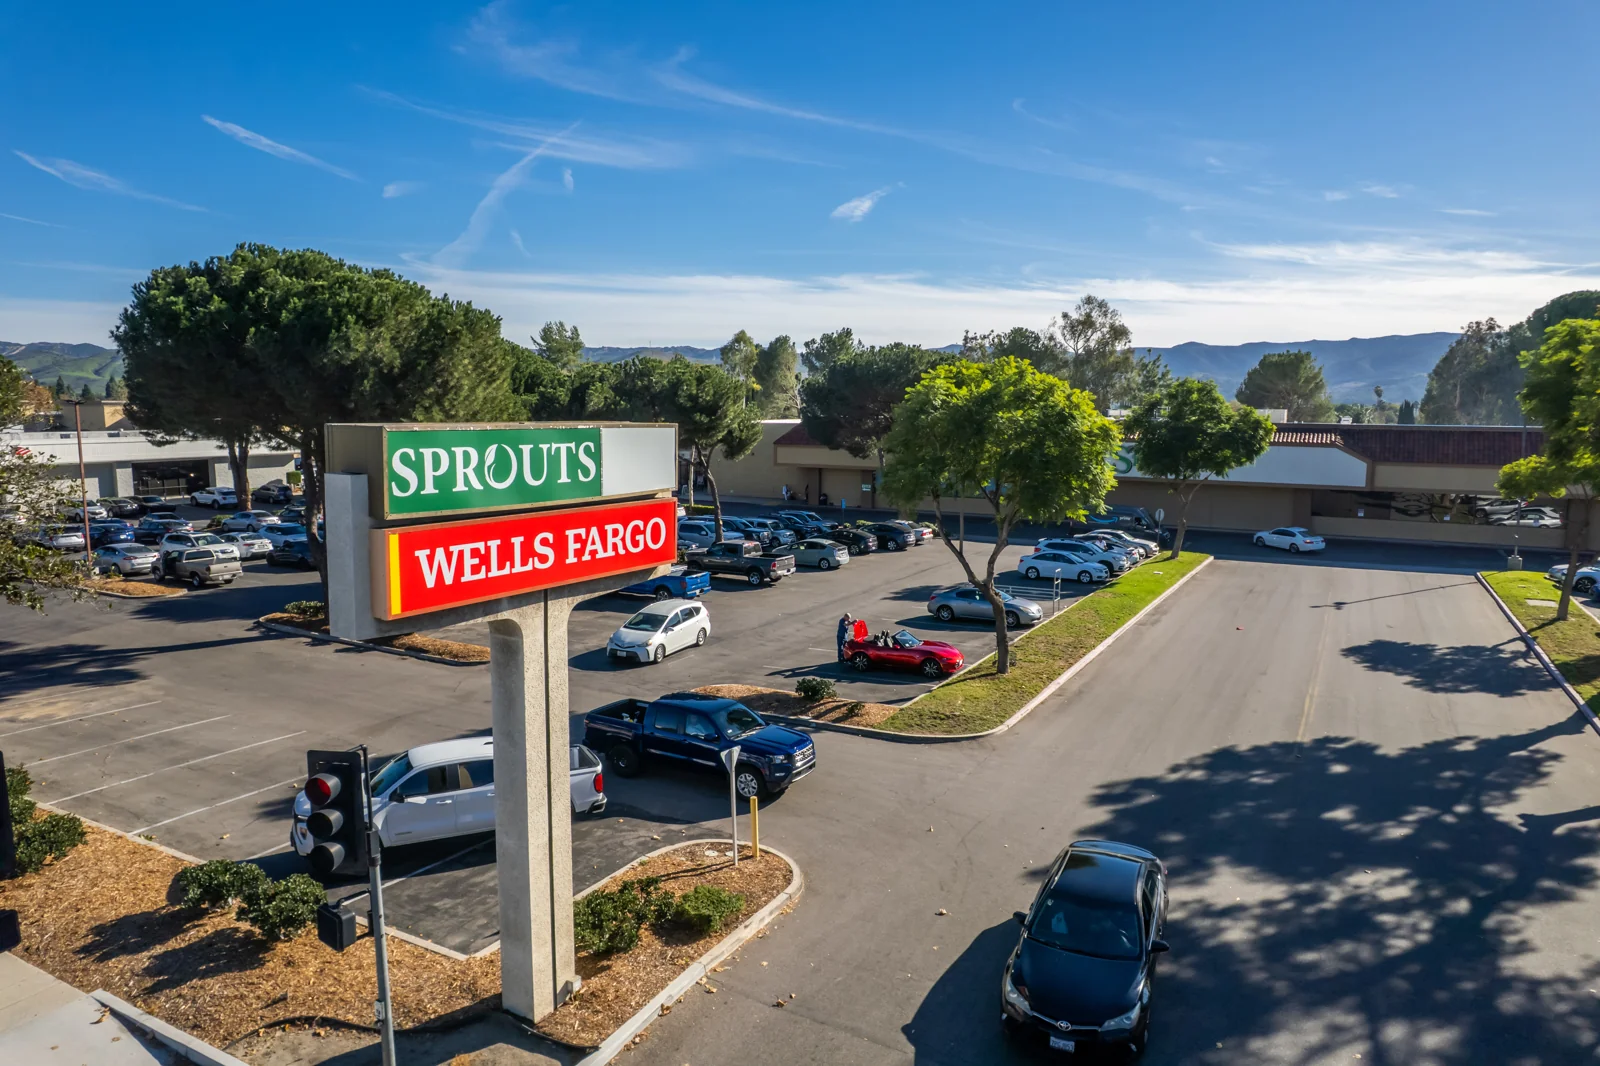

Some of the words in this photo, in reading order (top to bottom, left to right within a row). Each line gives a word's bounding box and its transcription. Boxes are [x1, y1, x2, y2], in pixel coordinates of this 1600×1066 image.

[391, 441, 597, 497] SPROUTS
[414, 532, 554, 589] WELLS
[565, 517, 667, 564] FARGO
